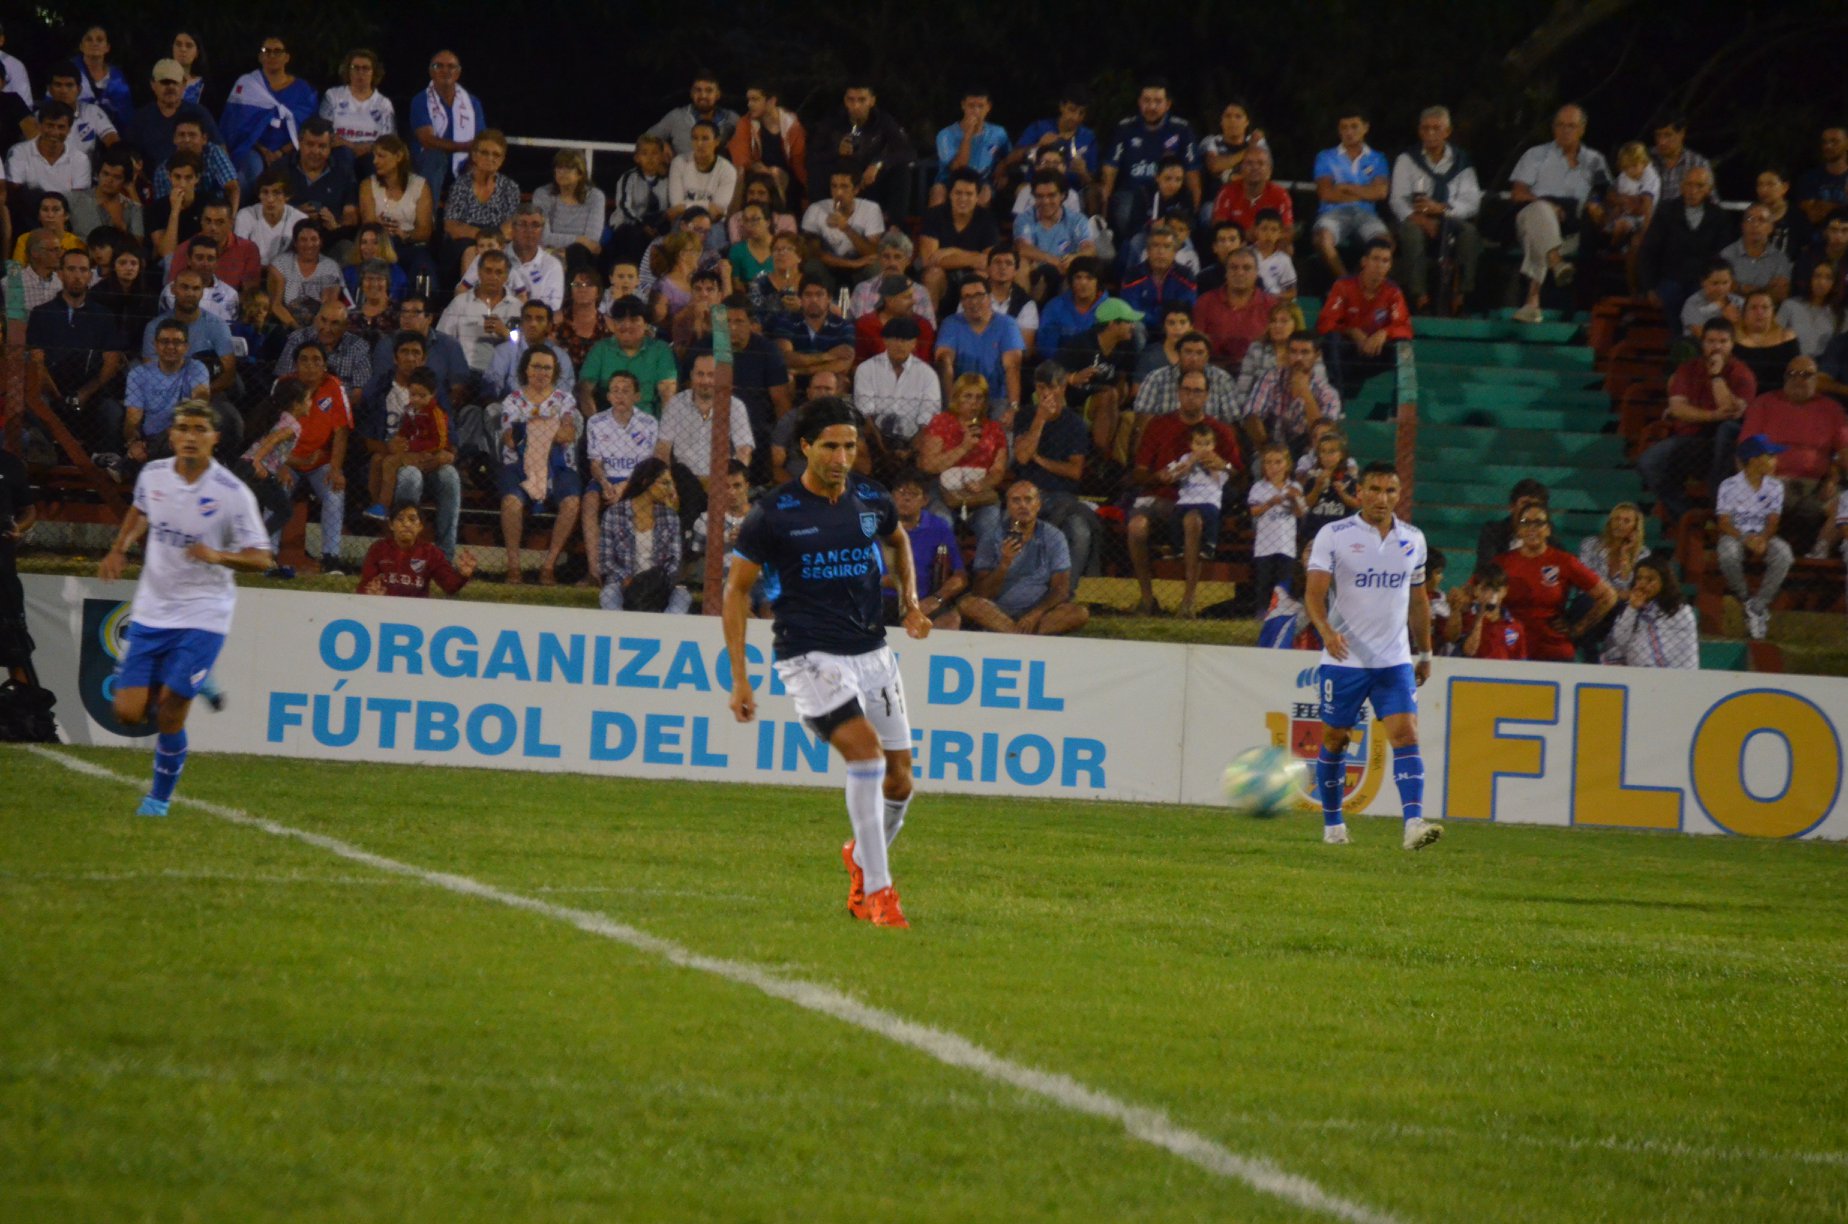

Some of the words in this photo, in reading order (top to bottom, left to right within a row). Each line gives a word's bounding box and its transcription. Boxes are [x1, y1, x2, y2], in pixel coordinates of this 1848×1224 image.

[802, 548, 871, 565] SANCOS
[802, 562, 868, 578] SEGUROS
[1355, 568, 1407, 588] antel
[318, 618, 900, 697] ORGANIZACI
[928, 654, 1065, 711] DEL
[1324, 679, 1333, 702] 9
[267, 679, 562, 758] FÚTBOL
[589, 710, 729, 768] DEL
[756, 719, 1107, 789] INRIOR
[1442, 675, 1844, 840] FLO
